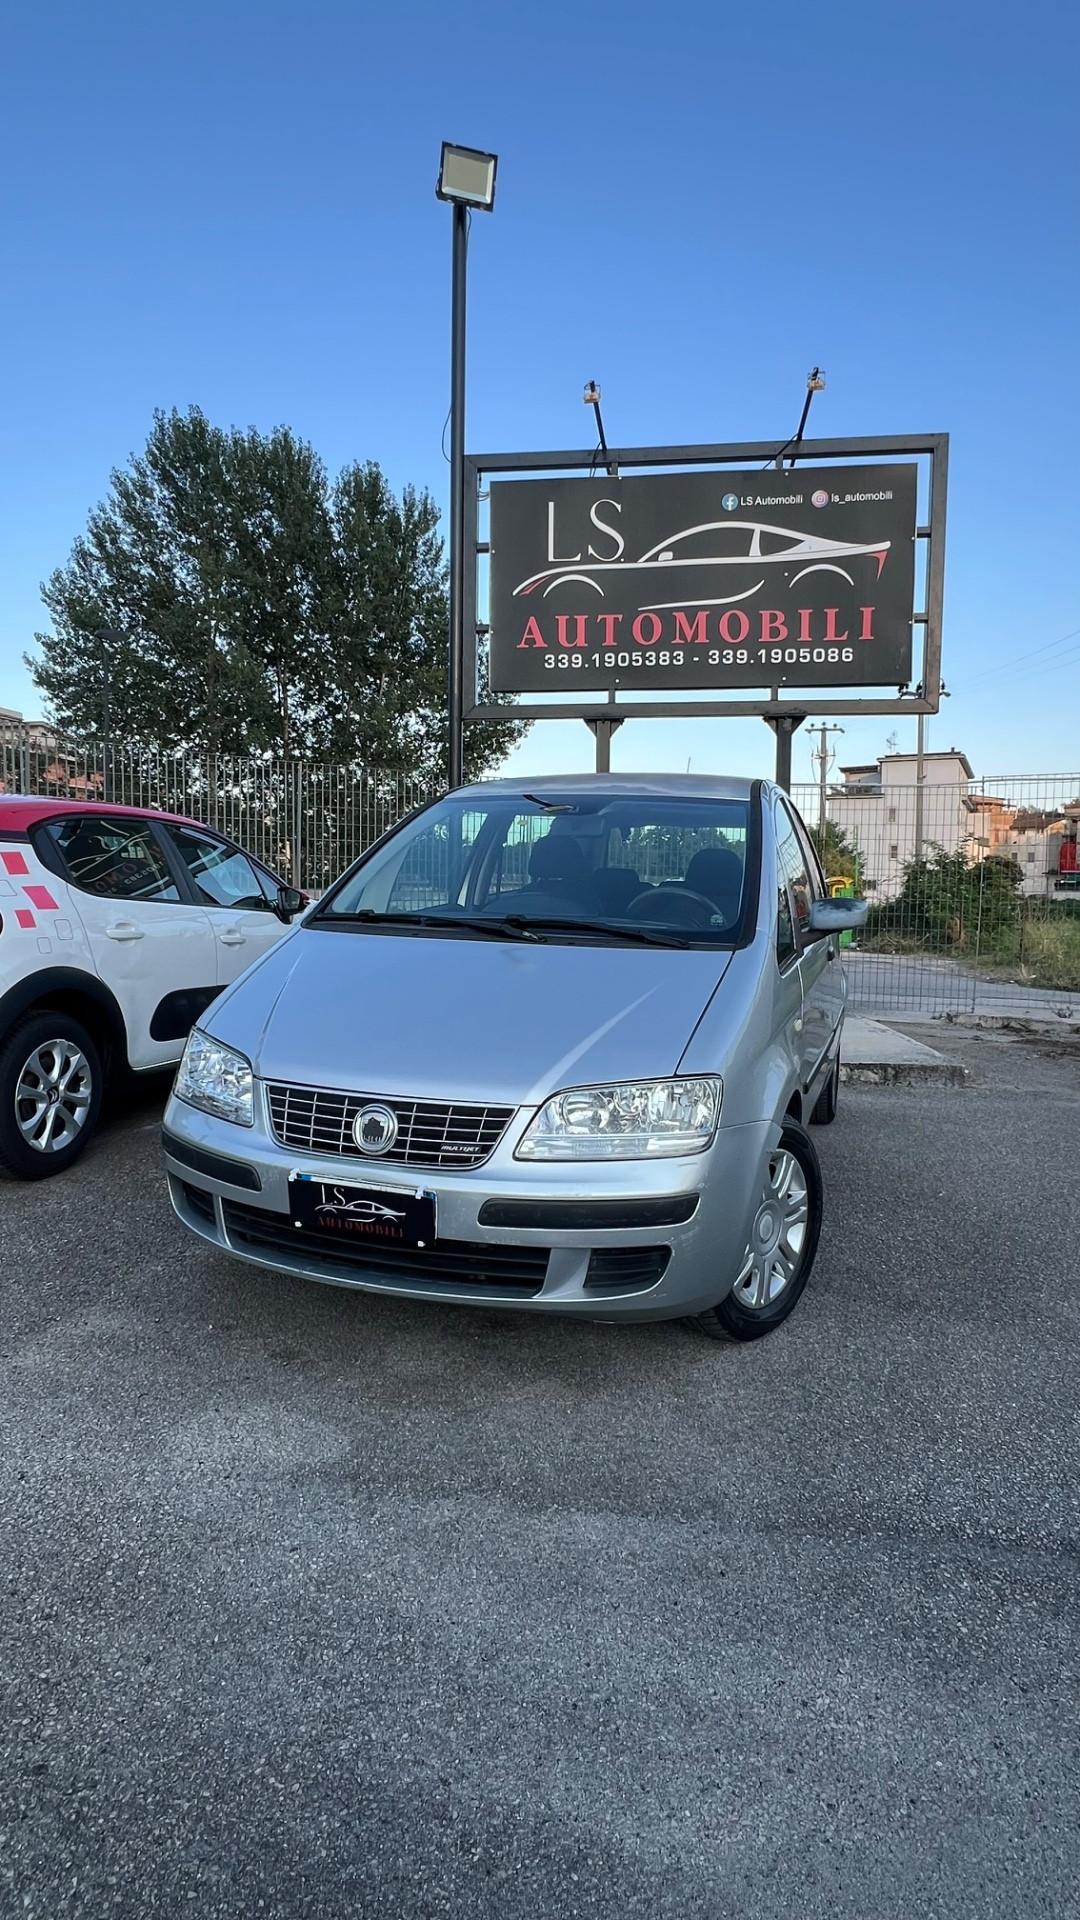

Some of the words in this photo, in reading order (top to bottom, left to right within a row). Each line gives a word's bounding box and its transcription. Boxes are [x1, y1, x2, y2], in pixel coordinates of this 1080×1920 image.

[740, 496, 753, 506] LS
[755, 494, 803, 506] Automobili
[831, 490, 893, 505] ls_automobili
[516, 606, 876, 649] AUTOMOBILI
[544, 650, 685, 669] 339.1905383
[707, 647, 854, 666] 339.1905086
